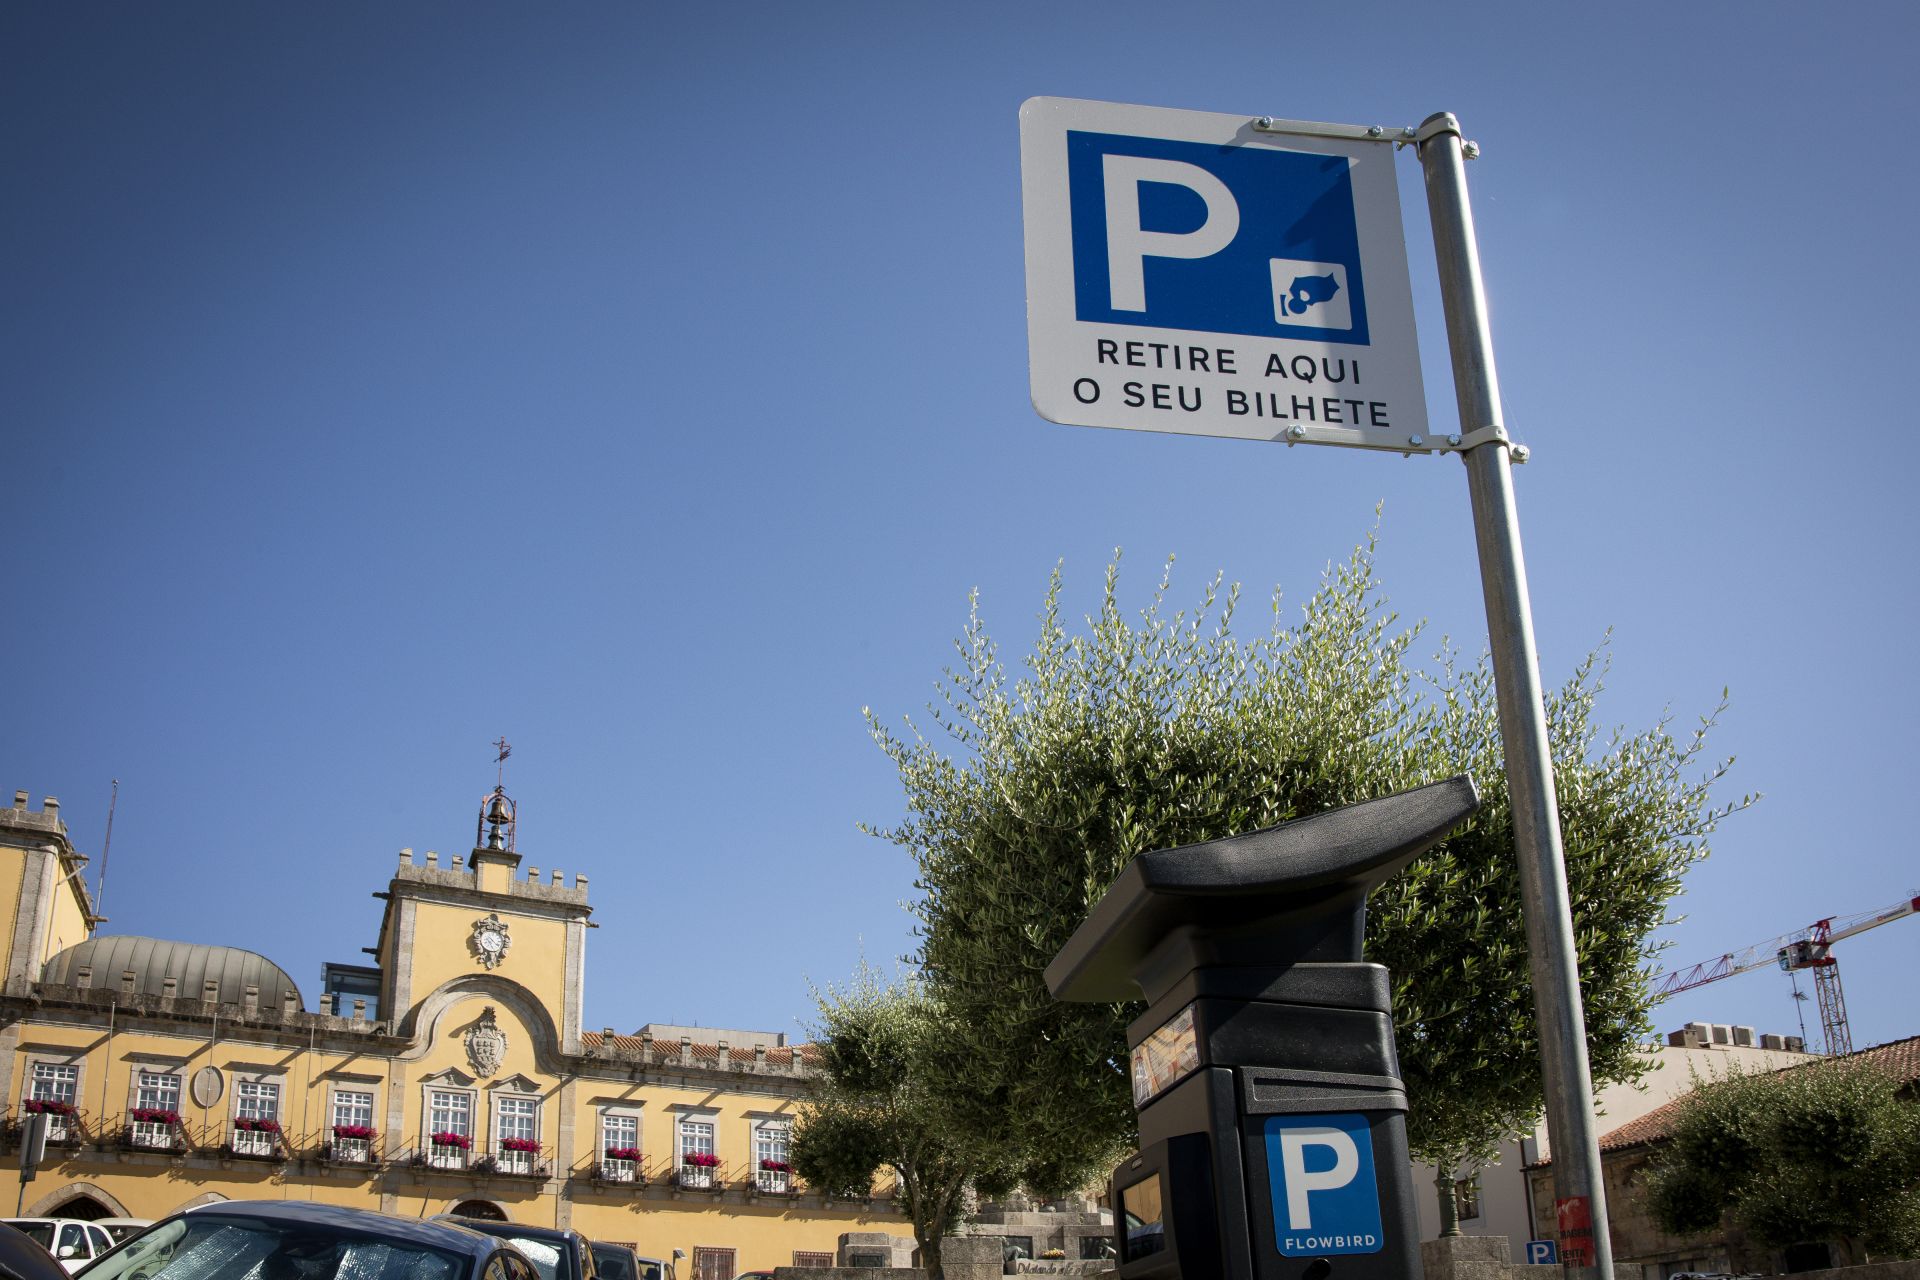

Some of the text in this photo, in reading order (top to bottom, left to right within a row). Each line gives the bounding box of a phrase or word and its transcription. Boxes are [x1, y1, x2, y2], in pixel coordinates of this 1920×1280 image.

[1102, 153, 1240, 313] P
[1097, 338, 1361, 384] RETIRE AQUI
[1073, 377, 1390, 427] O SEU BILHETE
[1279, 1126, 1359, 1230] P
[1285, 1234, 1376, 1250] FLOWBIRD
[1531, 1243, 1550, 1264] P
